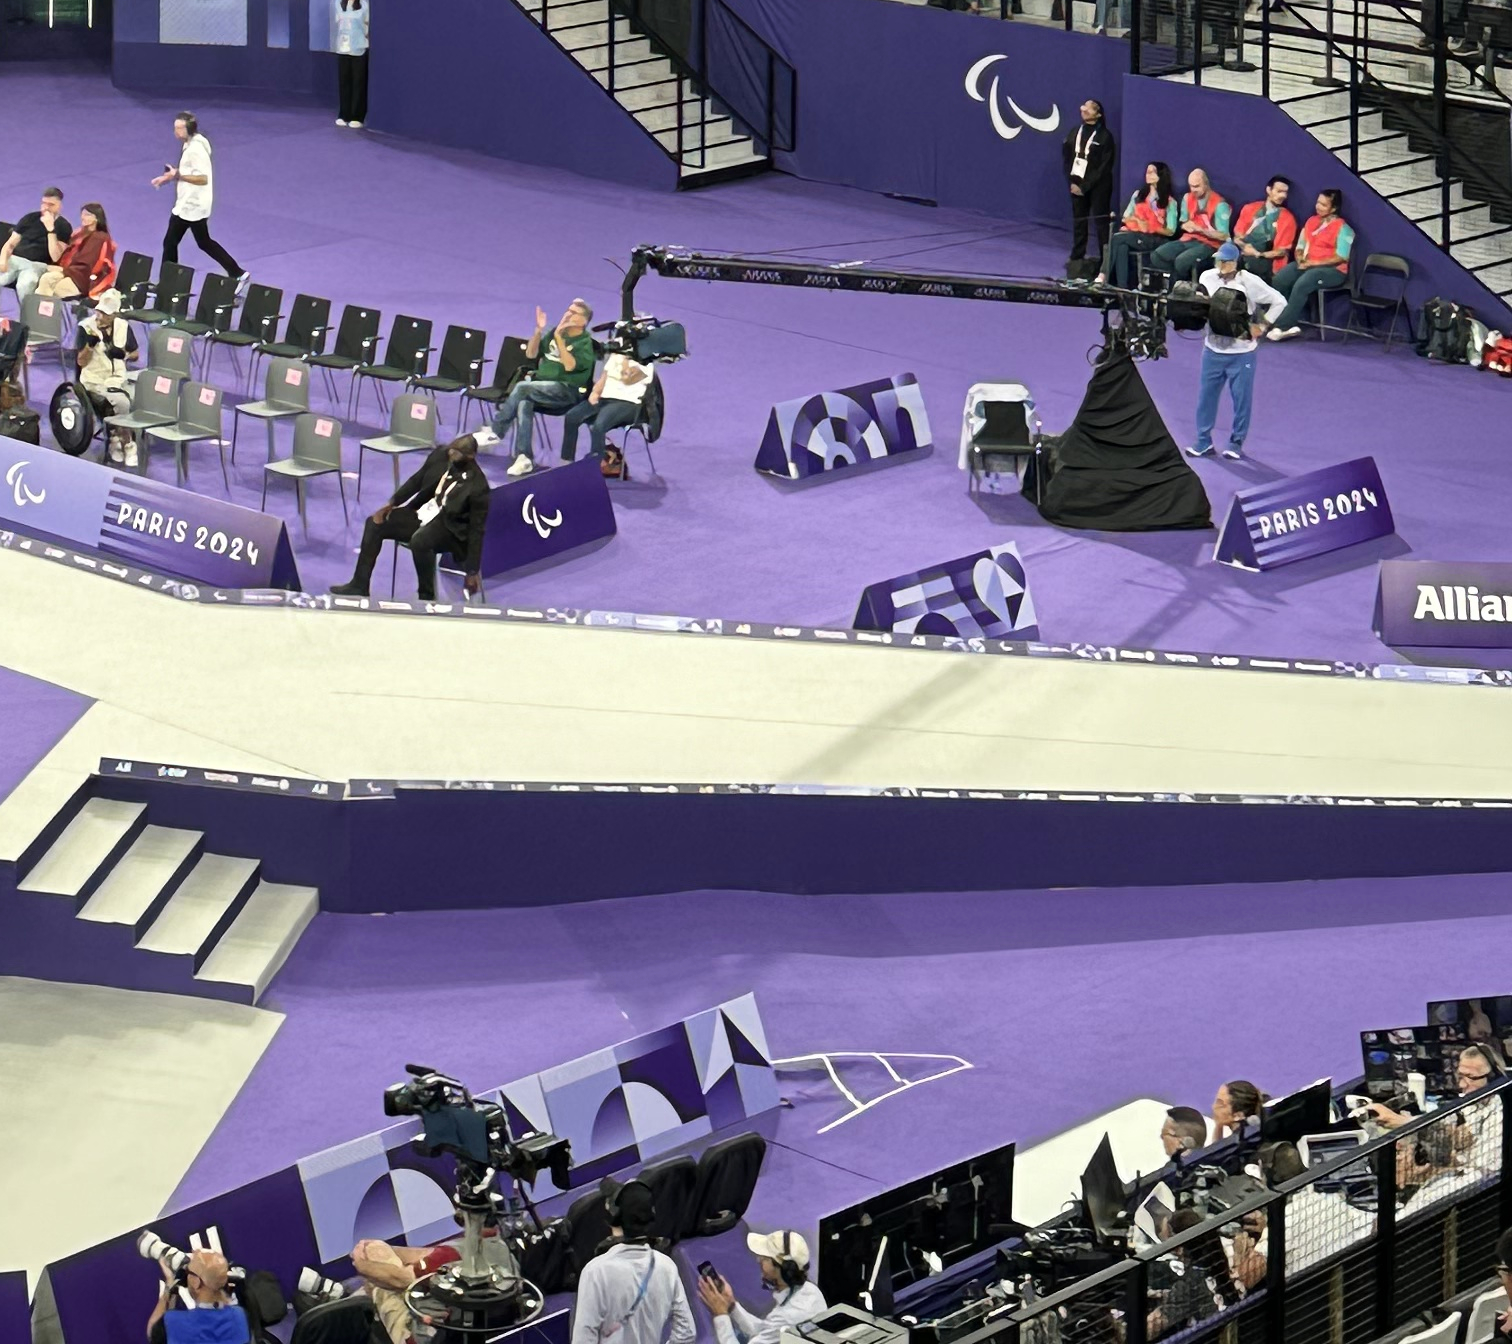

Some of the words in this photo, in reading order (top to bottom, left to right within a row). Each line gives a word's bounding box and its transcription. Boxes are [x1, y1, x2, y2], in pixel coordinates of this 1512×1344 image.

[117, 503, 187, 543] PARIS
[194, 527, 259, 566] 2024
[1259, 503, 1320, 539] PARIS
[1323, 487, 1378, 521] 2024
[1414, 585, 1512, 622] Allia
